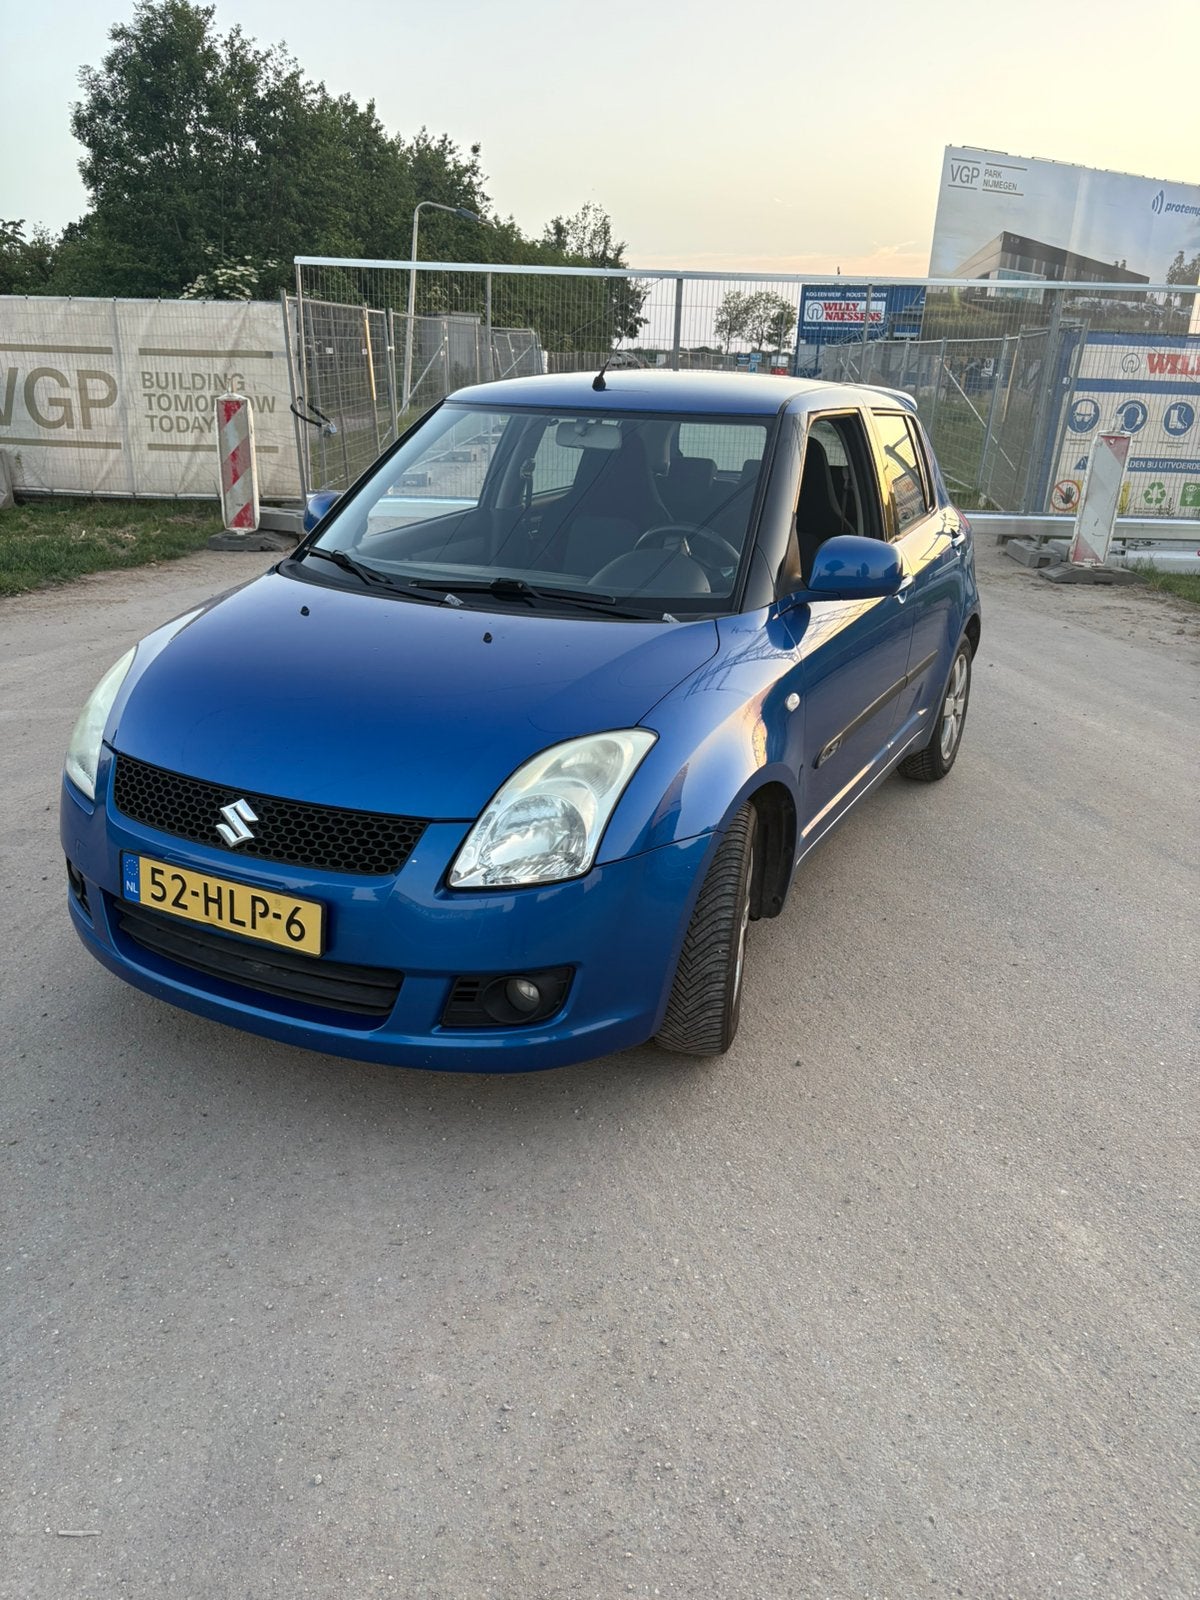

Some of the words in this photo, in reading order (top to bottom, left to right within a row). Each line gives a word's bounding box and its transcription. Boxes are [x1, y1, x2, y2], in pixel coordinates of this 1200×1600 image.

[951, 164, 980, 184] VGP
[984, 169, 1003, 179] PARK
[983, 179, 1018, 191] NIJMEGEN
[823, 302, 860, 312] WILLY
[825, 312, 882, 322] NAESSENS
[1147, 353, 1200, 376] WIL
[141, 371, 246, 391] BUILDING
[145, 415, 215, 434] TODAY
[1127, 460, 1146, 469] DEN
[126, 880, 138, 894] NL
[150, 866, 306, 942] 52-HLP-6
